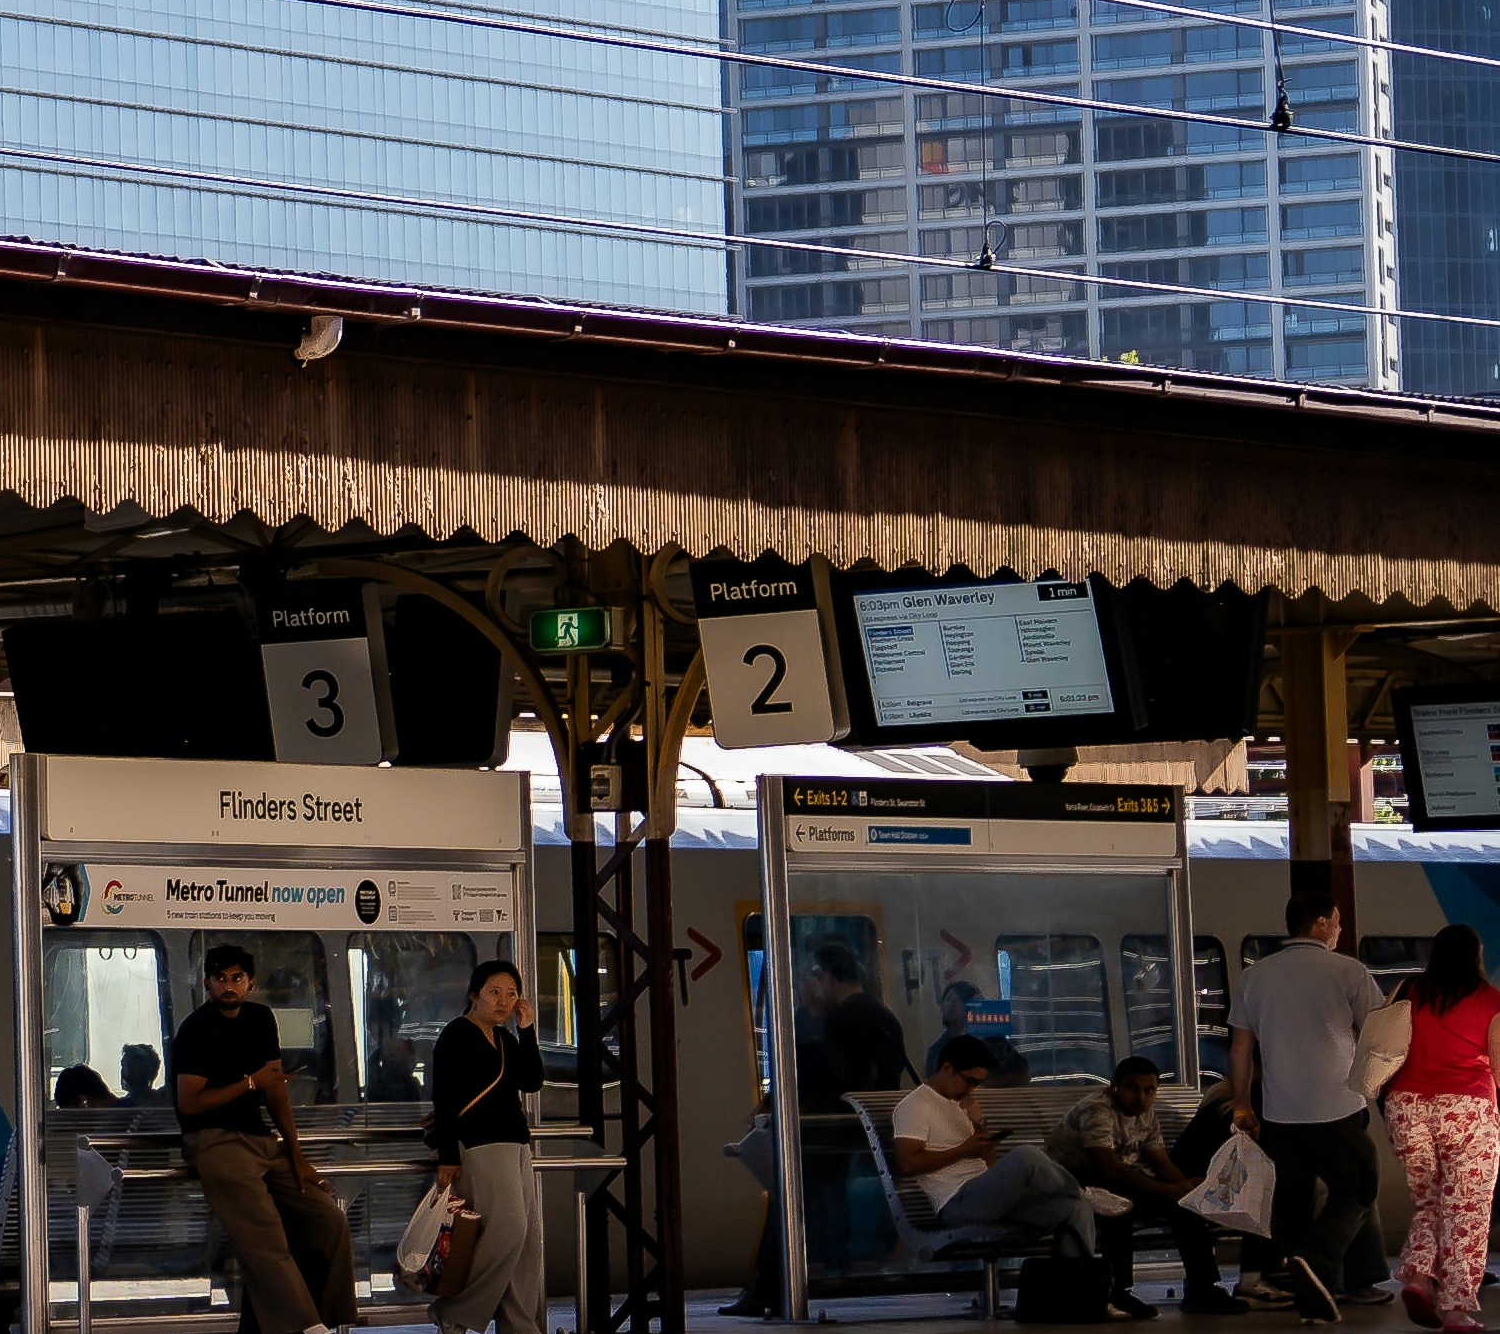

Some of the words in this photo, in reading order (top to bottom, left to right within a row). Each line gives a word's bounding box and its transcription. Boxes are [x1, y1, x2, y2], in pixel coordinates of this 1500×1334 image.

[709, 578, 799, 603] Platform
[859, 599, 900, 613] 6:03pm
[902, 595, 932, 609] Glen
[934, 590, 996, 607] Waverley
[1049, 587, 1056, 598] 1
[1057, 586, 1078, 597] min
[271, 604, 351, 631] Platform
[741, 643, 795, 717] 2
[299, 668, 345, 739] 3
[218, 789, 297, 823] Flinders
[300, 792, 365, 825] Street
[807, 789, 831, 806] Exits
[832, 790, 848, 806] 1-2
[1117, 797, 1140, 813] Exits
[808, 825, 856, 843] Platforms
[165, 878, 214, 903] Metro
[215, 878, 270, 904] Tunnel
[271, 886, 303, 904] now
[305, 885, 346, 910] open
